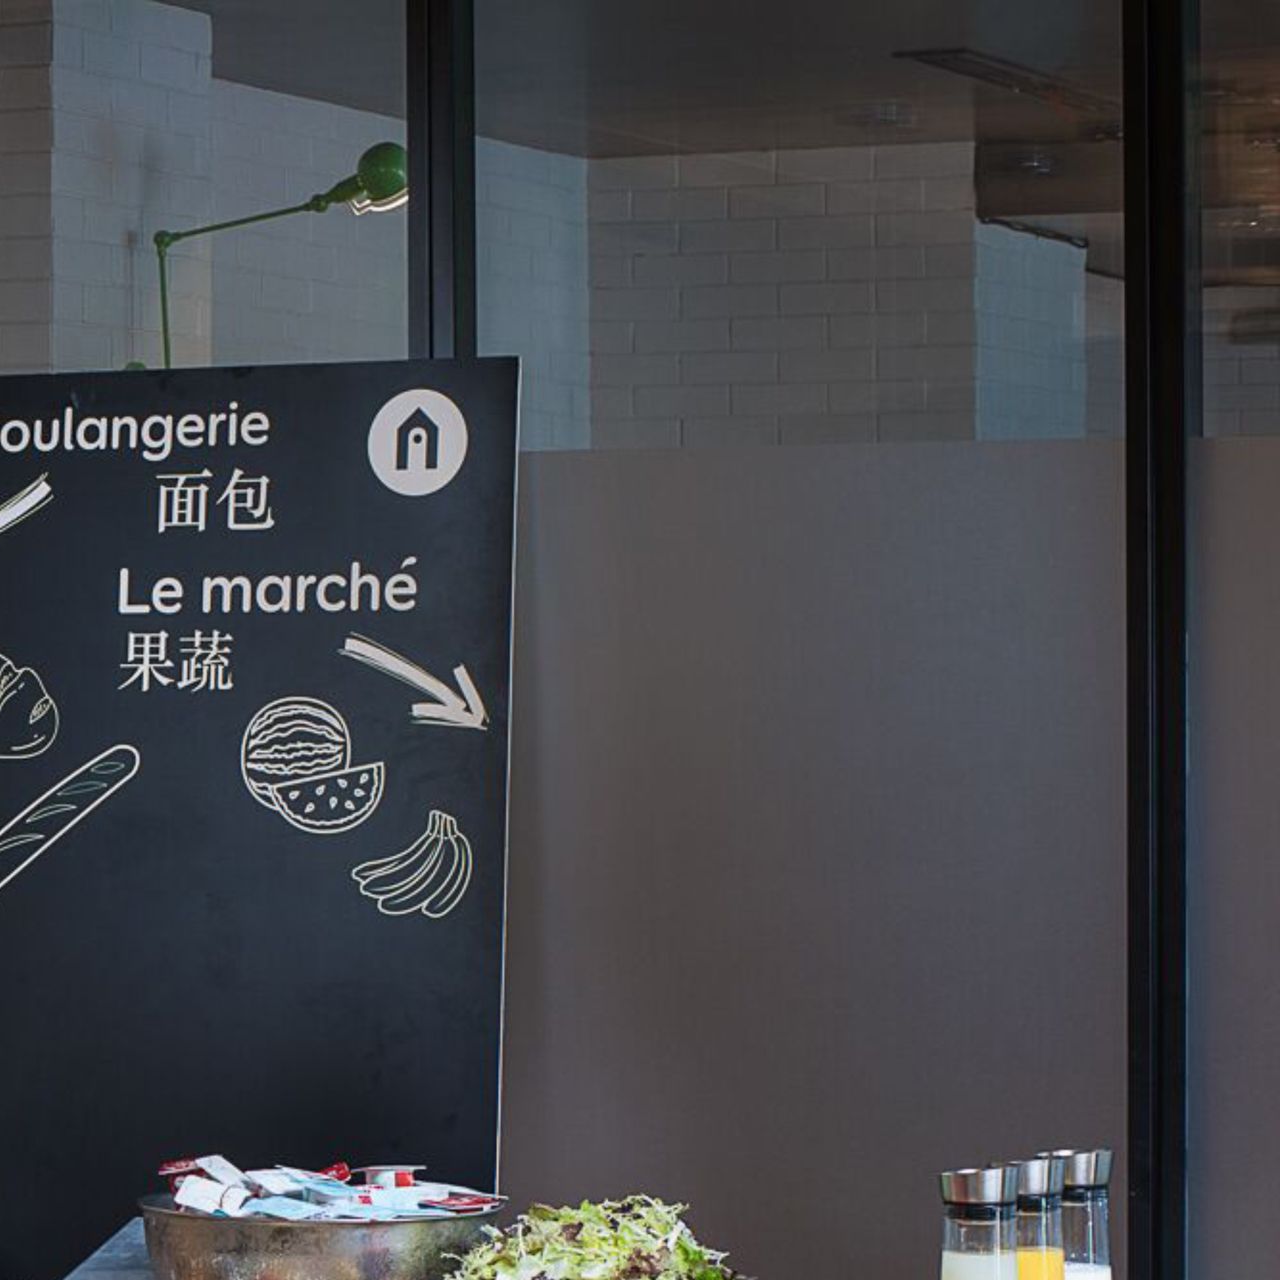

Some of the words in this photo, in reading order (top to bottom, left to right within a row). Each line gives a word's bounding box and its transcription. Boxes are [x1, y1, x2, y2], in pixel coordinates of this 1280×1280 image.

[155, 467, 276, 534] 面包
[118, 567, 183, 614] Le
[202, 556, 418, 613] marché
[118, 629, 234, 693] 果蔬
